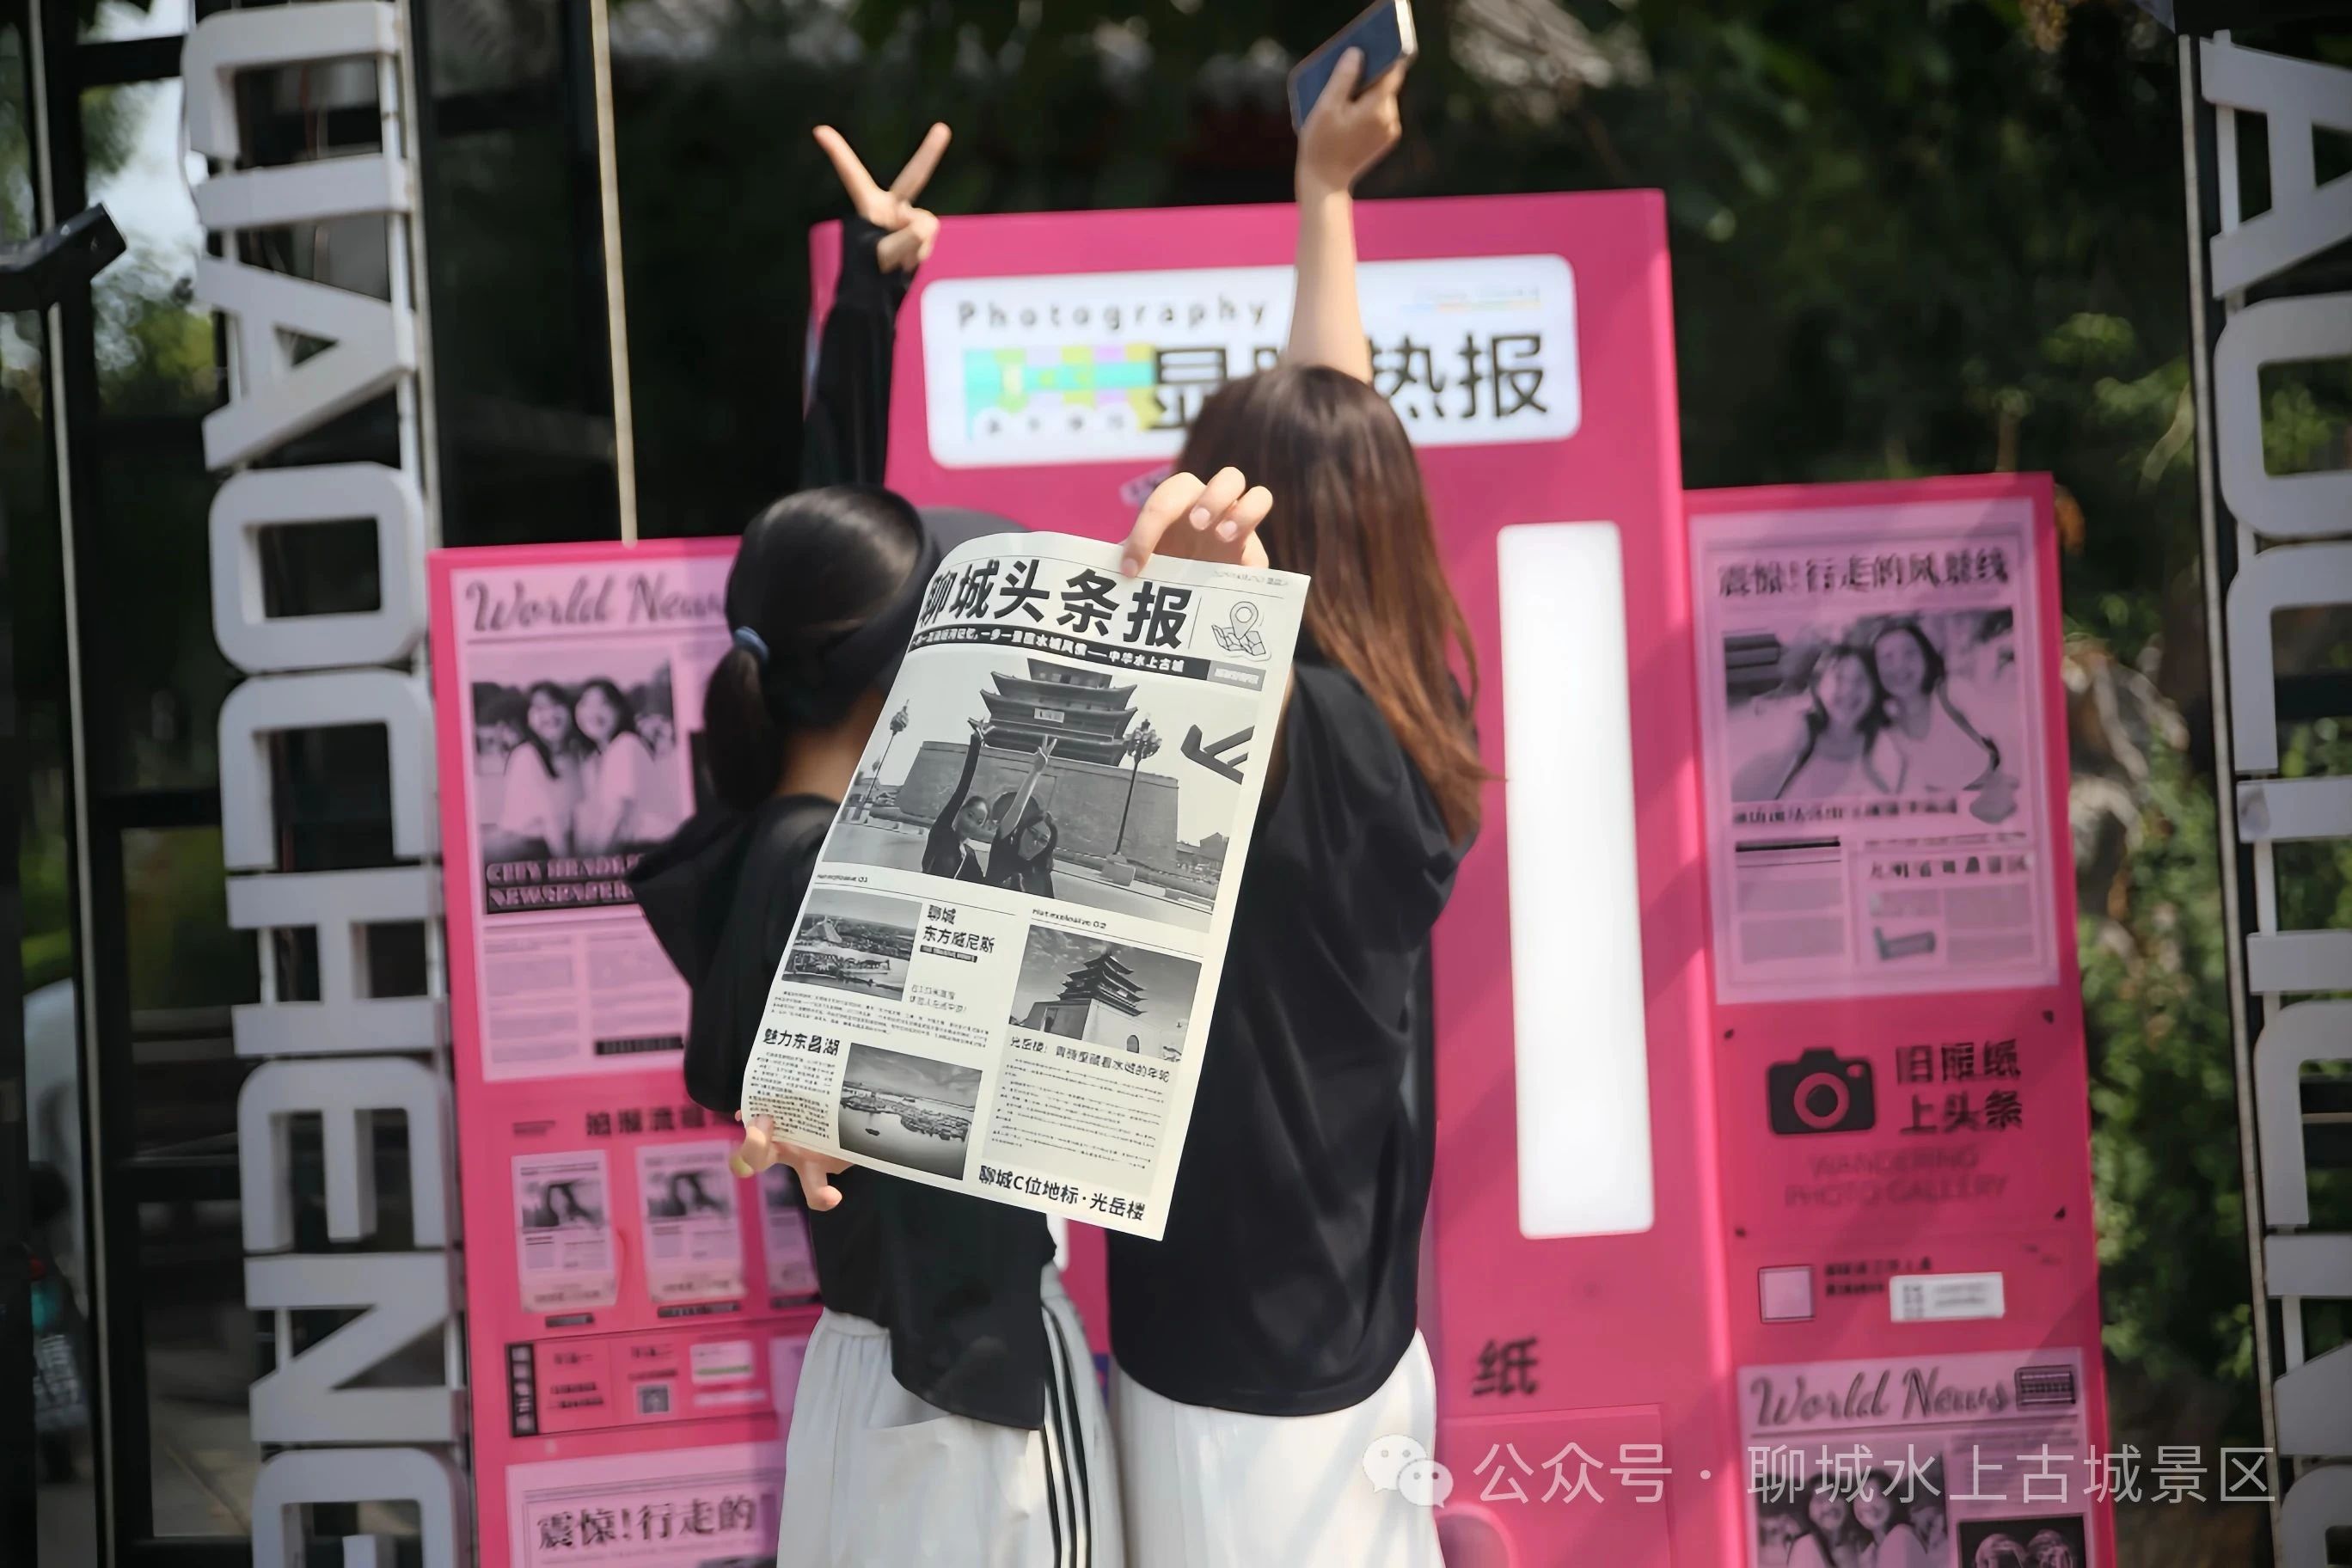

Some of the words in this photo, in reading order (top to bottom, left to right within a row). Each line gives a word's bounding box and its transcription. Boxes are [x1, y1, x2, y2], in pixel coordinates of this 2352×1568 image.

[958, 297, 1268, 333] Photography
[1152, 331, 1549, 432] 显热报
[465, 571, 616, 634] World
[919, 559, 1192, 649] 聊城头条报
[922, 925, 995, 953] 东方威尼斯
[928, 904, 957, 924] 聊城
[763, 1028, 840, 1057] 魅力东昌湖
[979, 1165, 1145, 1221] 聊城C位地标·光岳楼
[1750, 1370, 1892, 1428] World
[1902, 1366, 2014, 1418] News
[538, 1495, 776, 1551] 震惊！行走的
